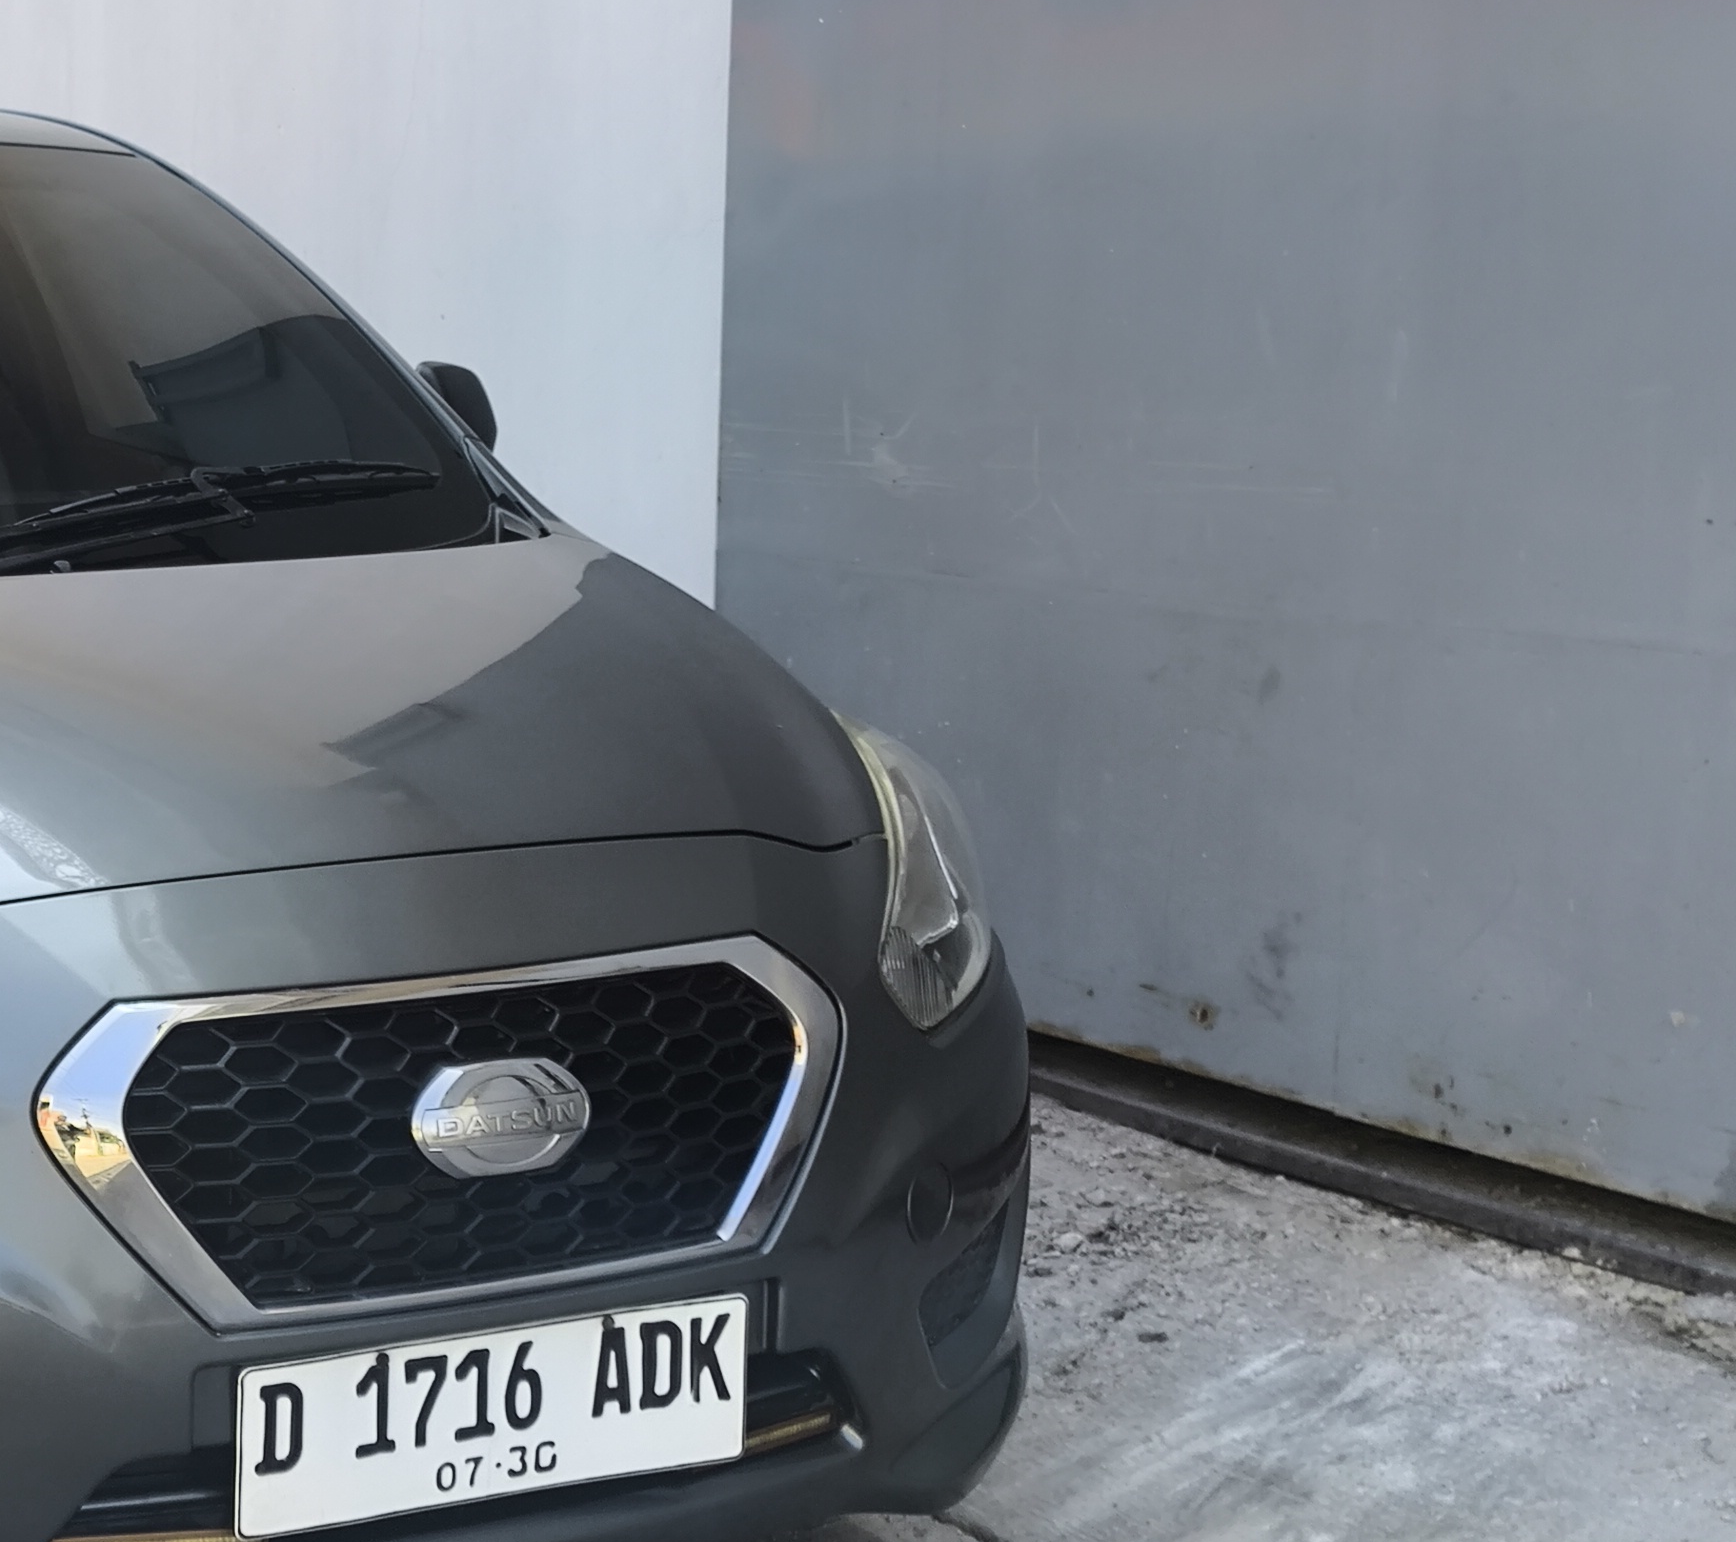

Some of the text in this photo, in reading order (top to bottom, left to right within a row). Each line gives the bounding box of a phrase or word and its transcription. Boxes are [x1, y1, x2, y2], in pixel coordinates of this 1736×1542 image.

[437, 1102, 577, 1138] DATSUN
[254, 1313, 731, 1476] D 1716 ADK
